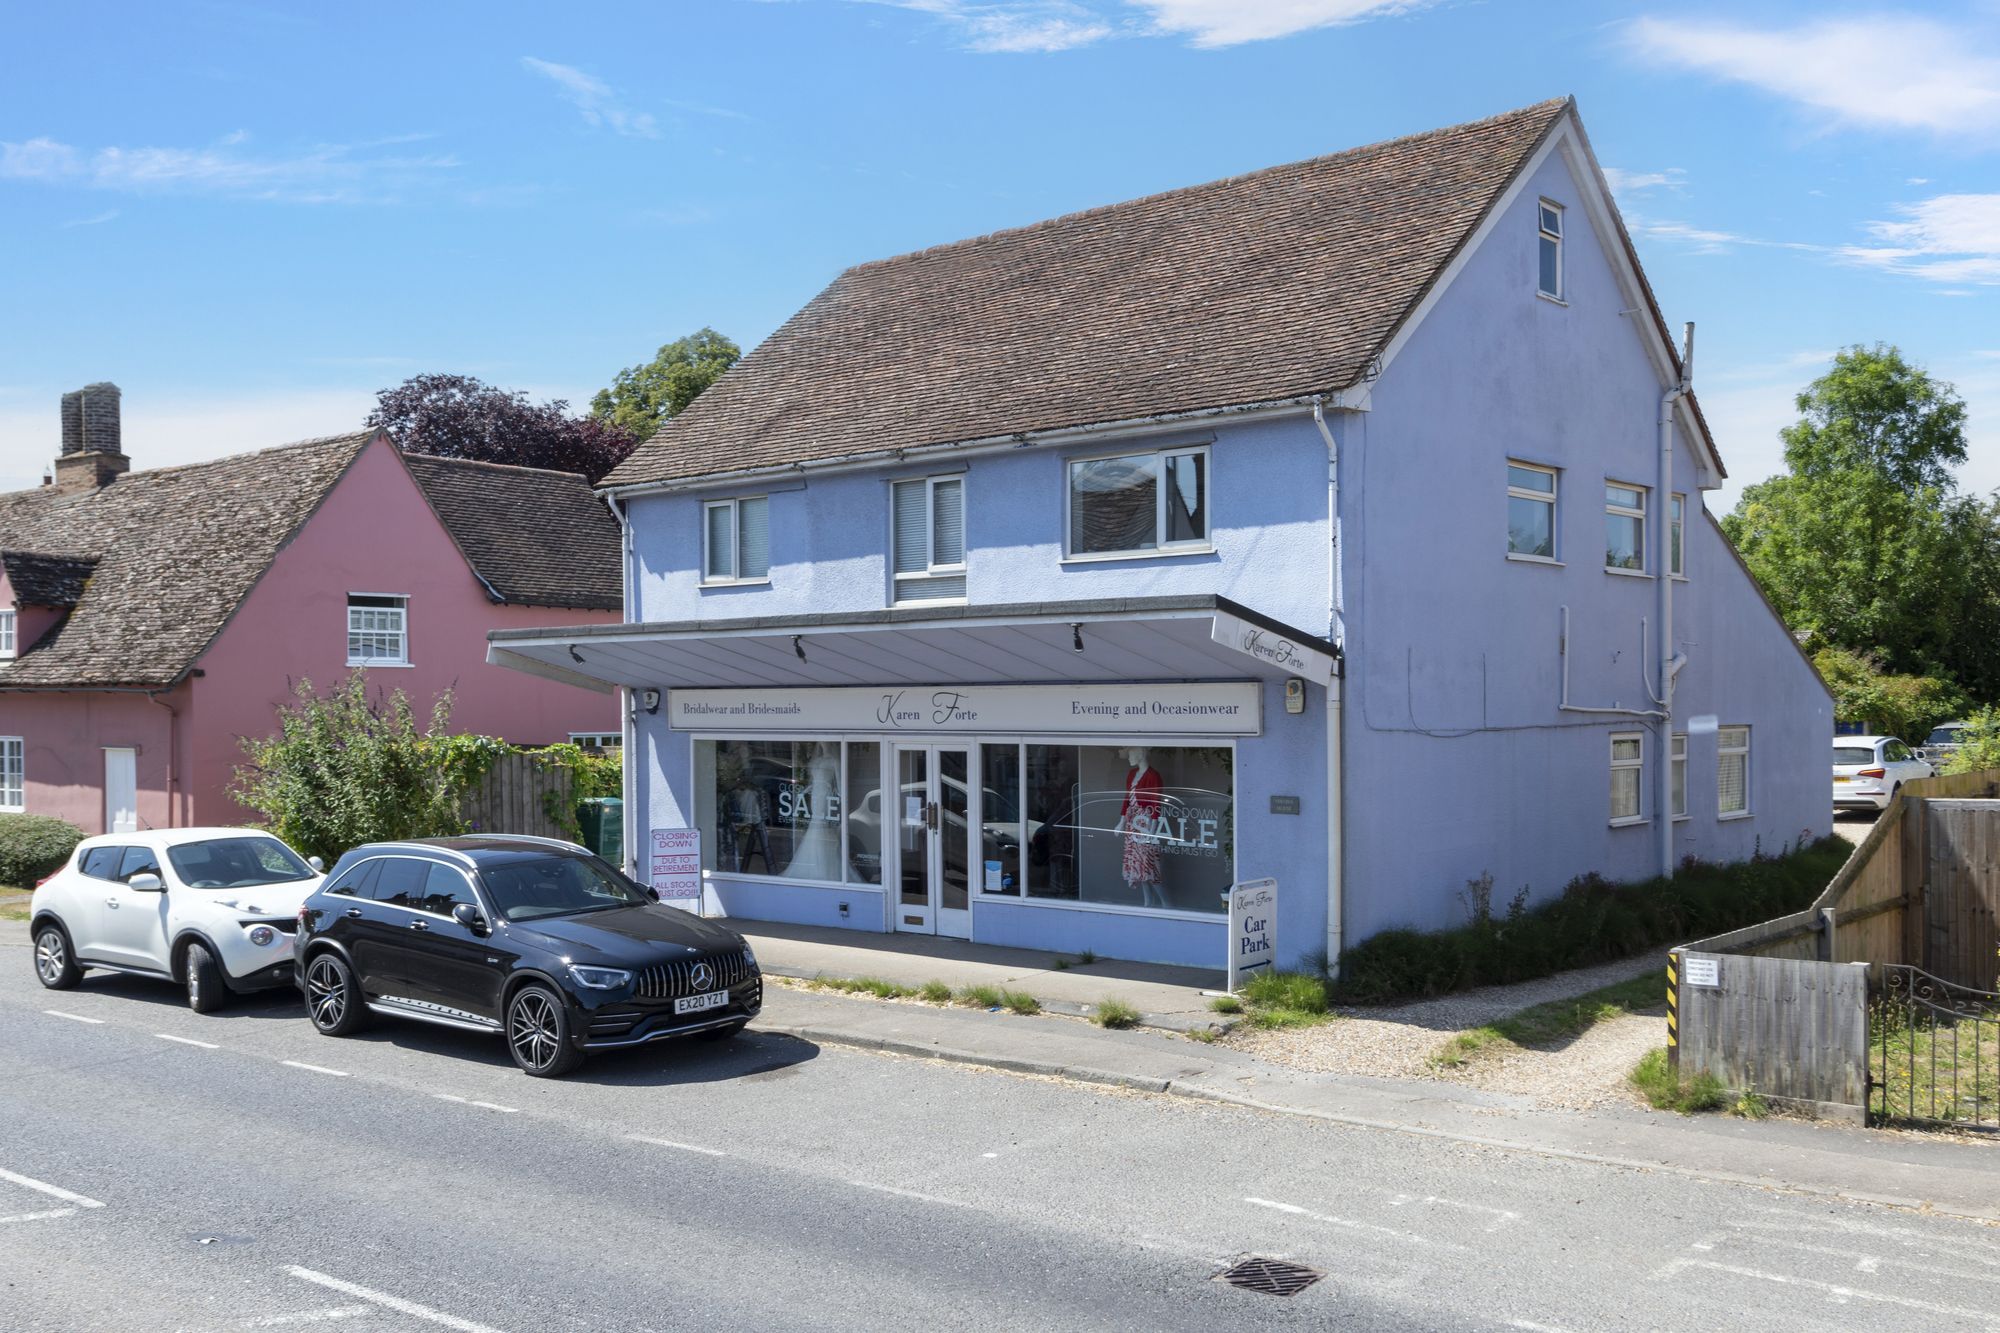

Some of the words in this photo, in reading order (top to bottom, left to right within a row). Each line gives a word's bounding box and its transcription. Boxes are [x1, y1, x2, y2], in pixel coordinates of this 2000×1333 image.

[1244, 629, 1274, 657] Karen
[1275, 640, 1304, 670] Forte
[683, 702, 728, 715] Bridalwear
[729, 703, 746, 715] and
[747, 702, 801, 715] Bridesmaids
[876, 690, 921, 728] Karen
[932, 691, 978, 725] Forte
[1071, 701, 1120, 720] Evening
[1124, 702, 1147, 715] and
[1151, 701, 1240, 715] Occasionwear
[778, 791, 841, 821] SALE
[1181, 807, 1219, 820] DOWN
[653, 832, 699, 841] CLOSING
[1132, 814, 1218, 849] SALE
[659, 840, 693, 849] DOWN
[653, 864, 699, 873] RETIREMENT
[661, 857, 677, 865] DUE
[680, 856, 690, 864] TO
[671, 881, 697, 889] STOCK
[1244, 916, 1267, 934] Car
[1240, 933, 1271, 955] Park
[679, 996, 705, 1011] EX20
[706, 991, 725, 1006] YZT
